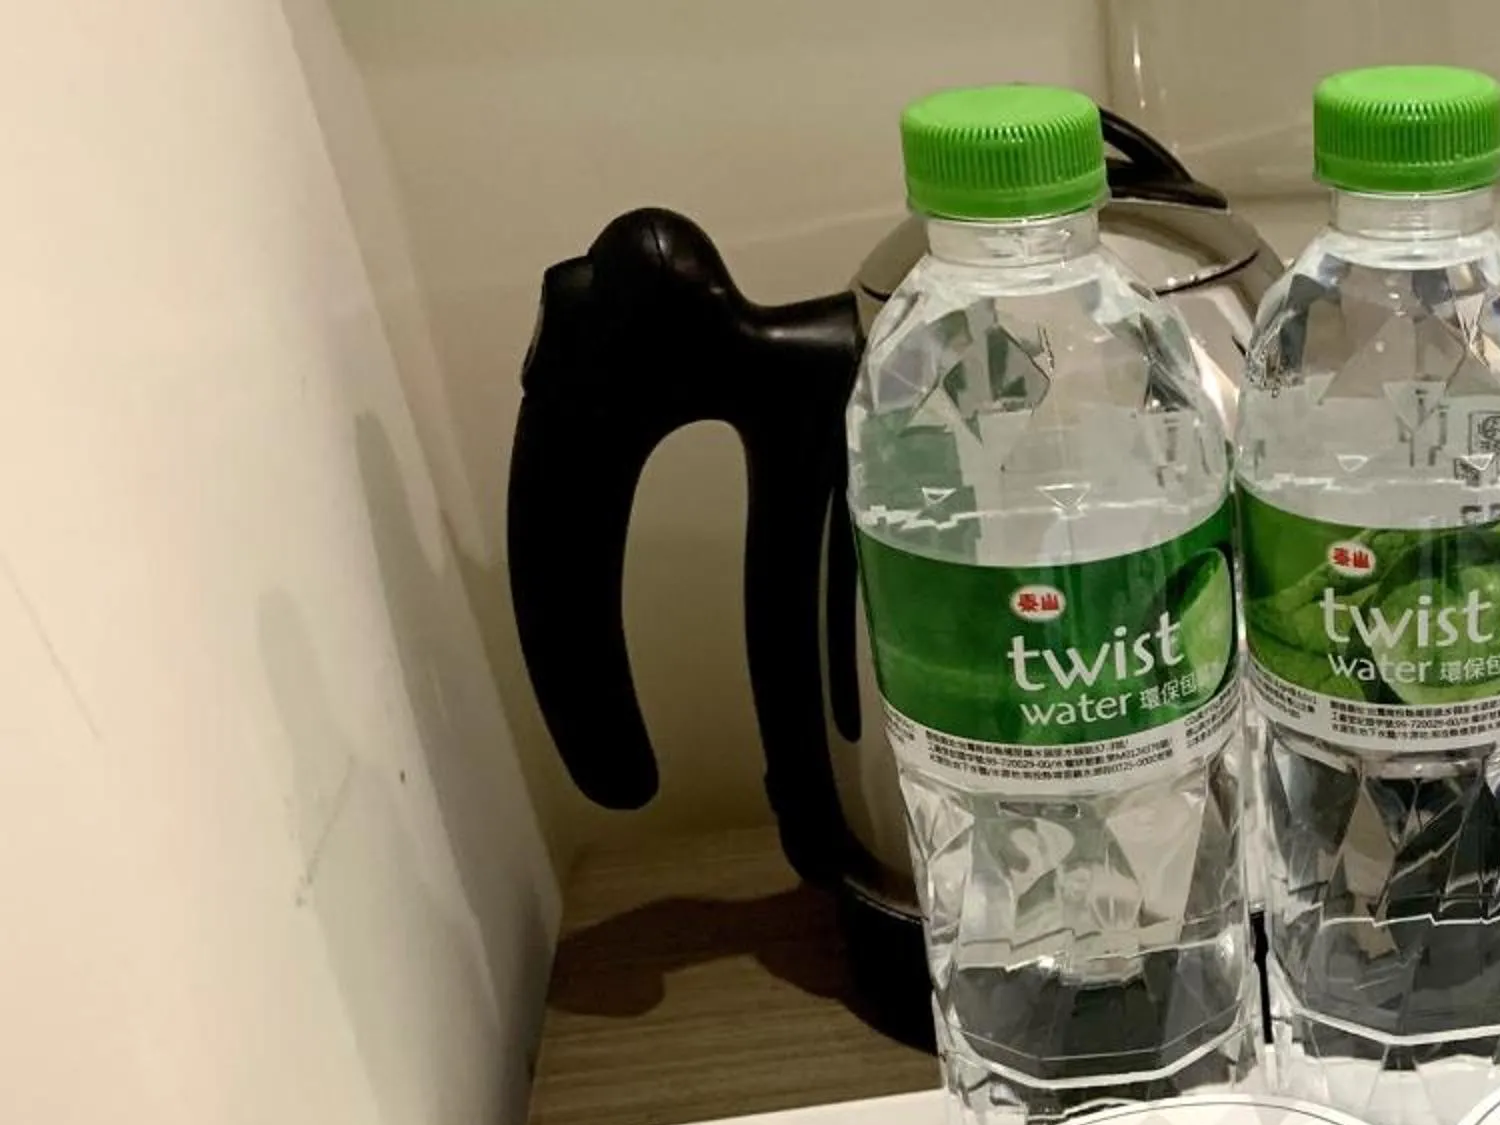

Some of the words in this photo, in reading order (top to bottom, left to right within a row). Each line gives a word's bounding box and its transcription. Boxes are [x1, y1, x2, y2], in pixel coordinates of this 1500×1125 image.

[1320, 587, 1494, 649] twist
[1007, 611, 1184, 692] twist
[1328, 653, 1432, 685] water
[1020, 692, 1132, 726] water
